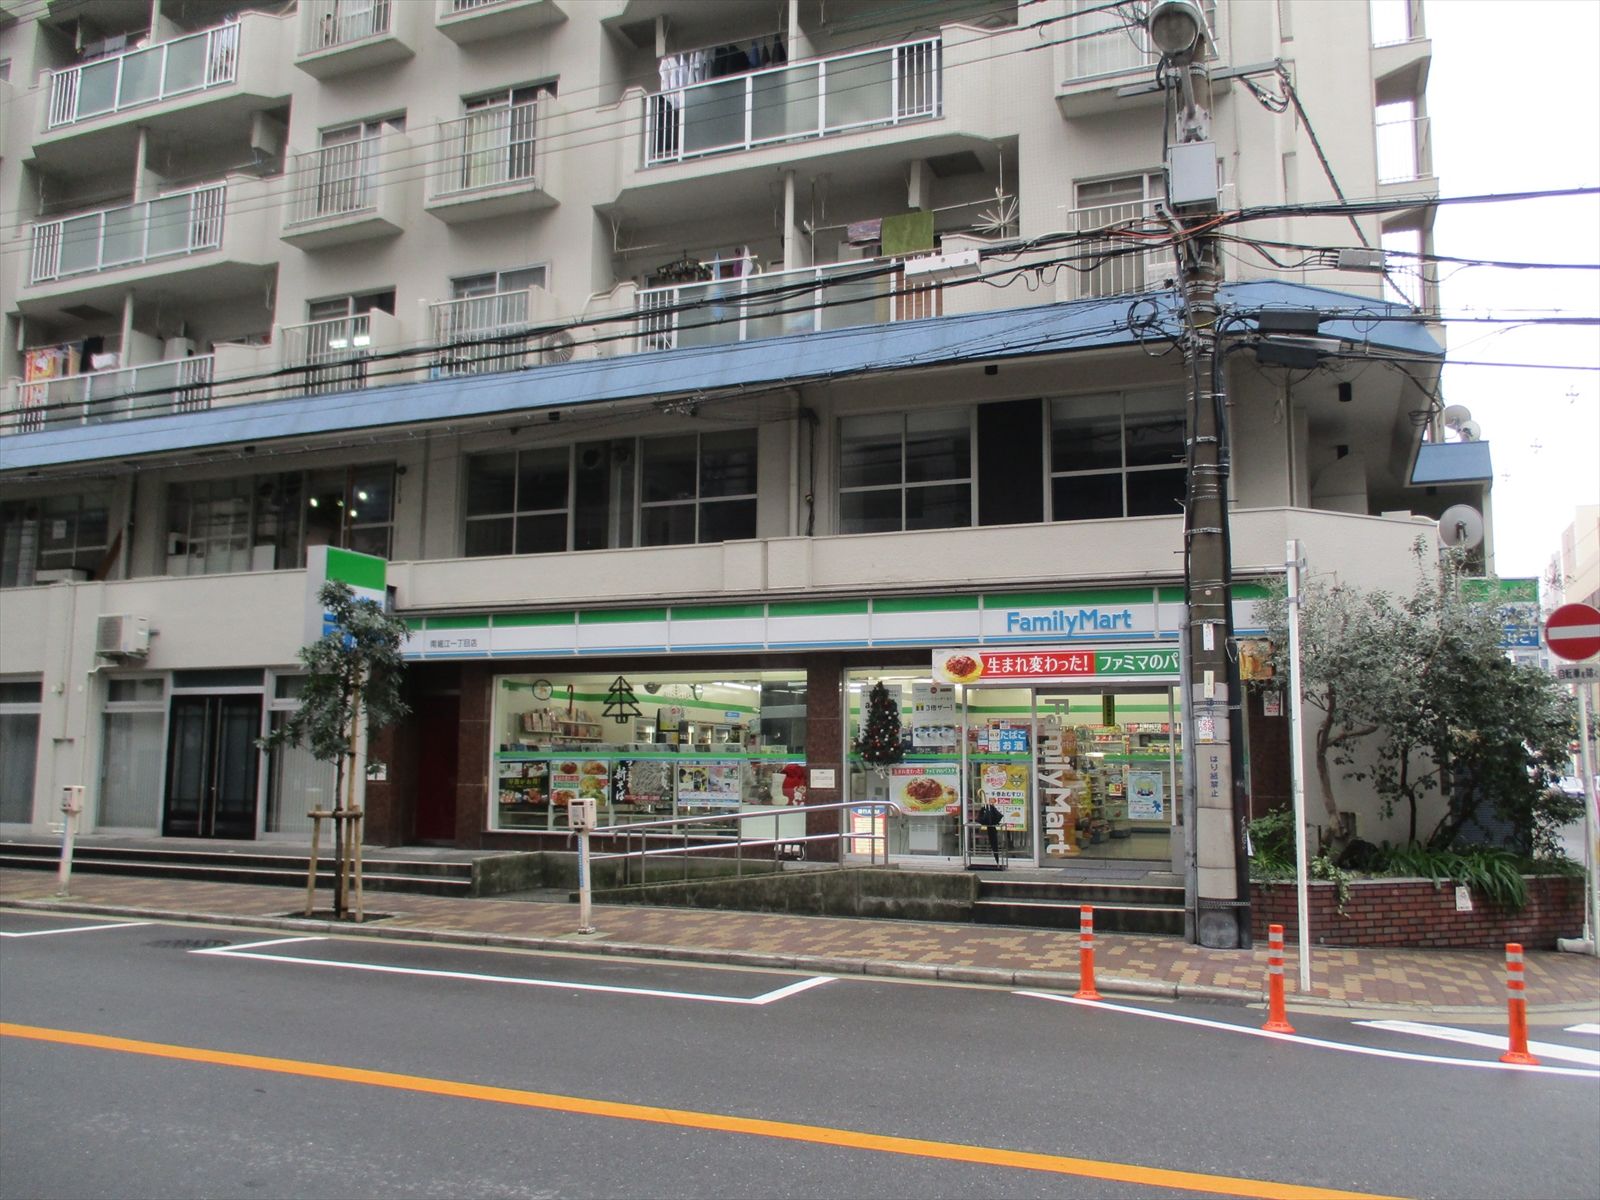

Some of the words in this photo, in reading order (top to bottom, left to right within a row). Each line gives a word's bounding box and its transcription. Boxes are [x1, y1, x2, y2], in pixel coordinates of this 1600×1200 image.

[1007, 608, 1132, 637] FamilyMart
[987, 655, 1088, 674] 生まれ変わった!
[1000, 730, 1026, 740] たばこ
[1002, 741, 1024, 751] お酒
[1039, 698, 1071, 854] FamilyMart
[1209, 755, 1219, 798] はり紙禁止
